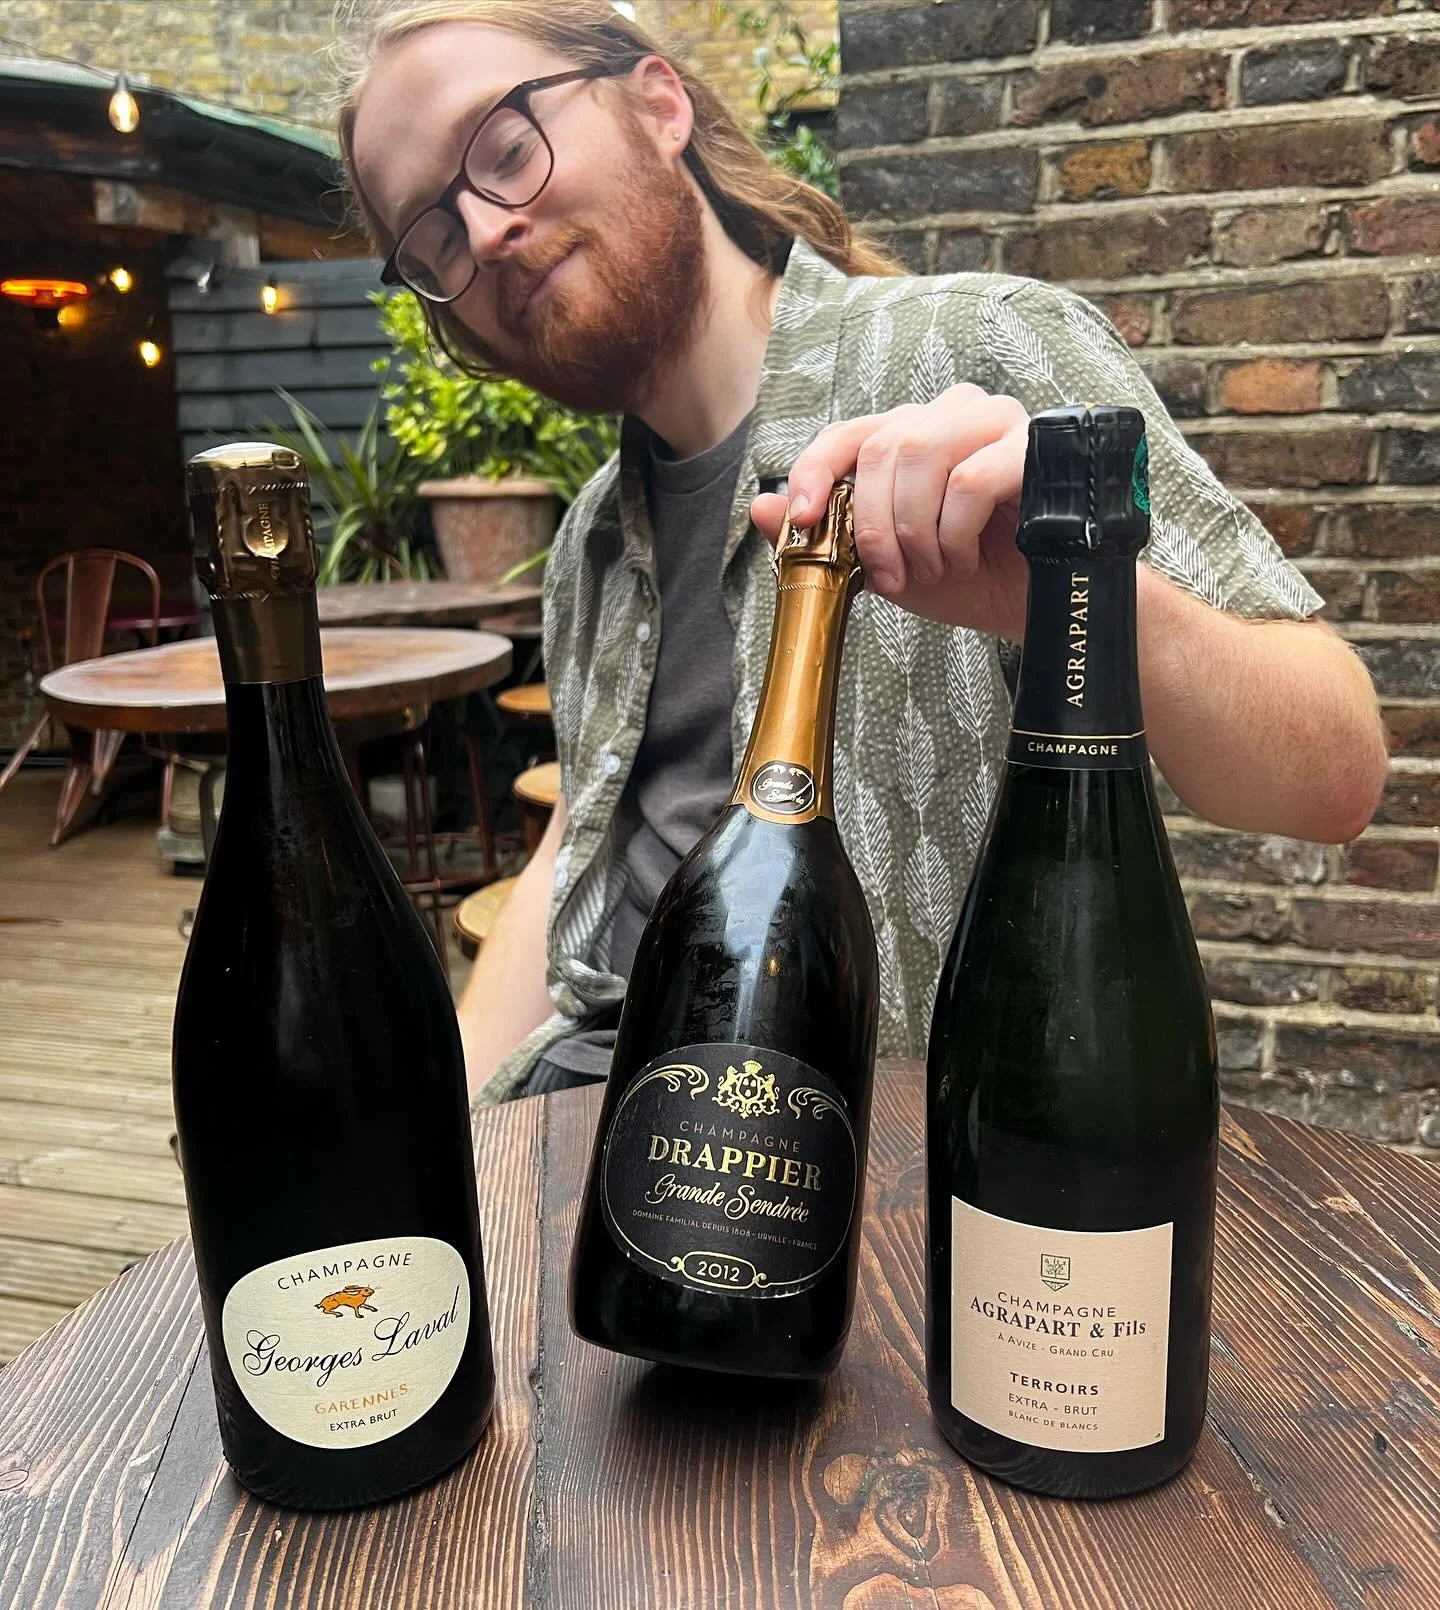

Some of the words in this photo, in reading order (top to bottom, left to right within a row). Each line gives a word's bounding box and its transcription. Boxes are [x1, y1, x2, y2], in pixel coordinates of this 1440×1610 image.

[1066, 571, 1089, 708] AGRAPART
[1027, 741, 1118, 757] CHAMPAGNE
[679, 1120, 801, 1151] CHAMPAGNE
[647, 1134, 822, 1192] DRAPPIER
[644, 1173, 726, 1205] Grande
[724, 1184, 809, 1223] Sendrée
[632, 1209, 663, 1221] DOMAINE
[665, 1215, 700, 1228] FAMILIAL
[702, 1222, 730, 1234] DEPUIS
[277, 1252, 413, 1290] CHAMPAGNE
[696, 1261, 740, 1282] 2012
[970, 1296, 1081, 1338] AGRAPART
[1089, 1323, 1105, 1338] &
[1113, 1320, 1147, 1338] Fils
[997, 1291, 1117, 1318] CHAMPAGNE
[242, 1329, 363, 1387] Georges
[371, 1285, 460, 1362] Laval
[1010, 1371, 1099, 1396] TERROIRS
[314, 1383, 409, 1415] GARENNES
[1008, 1393, 1048, 1412] EXTRA
[1064, 1405, 1098, 1416] BRUT
[329, 1419, 366, 1432] EXTRA
[369, 1408, 398, 1424] BRUT
[1008, 1410, 1039, 1424] BLANC
[1043, 1420, 1056, 1428] DE
[1060, 1422, 1098, 1431] BLANCS
